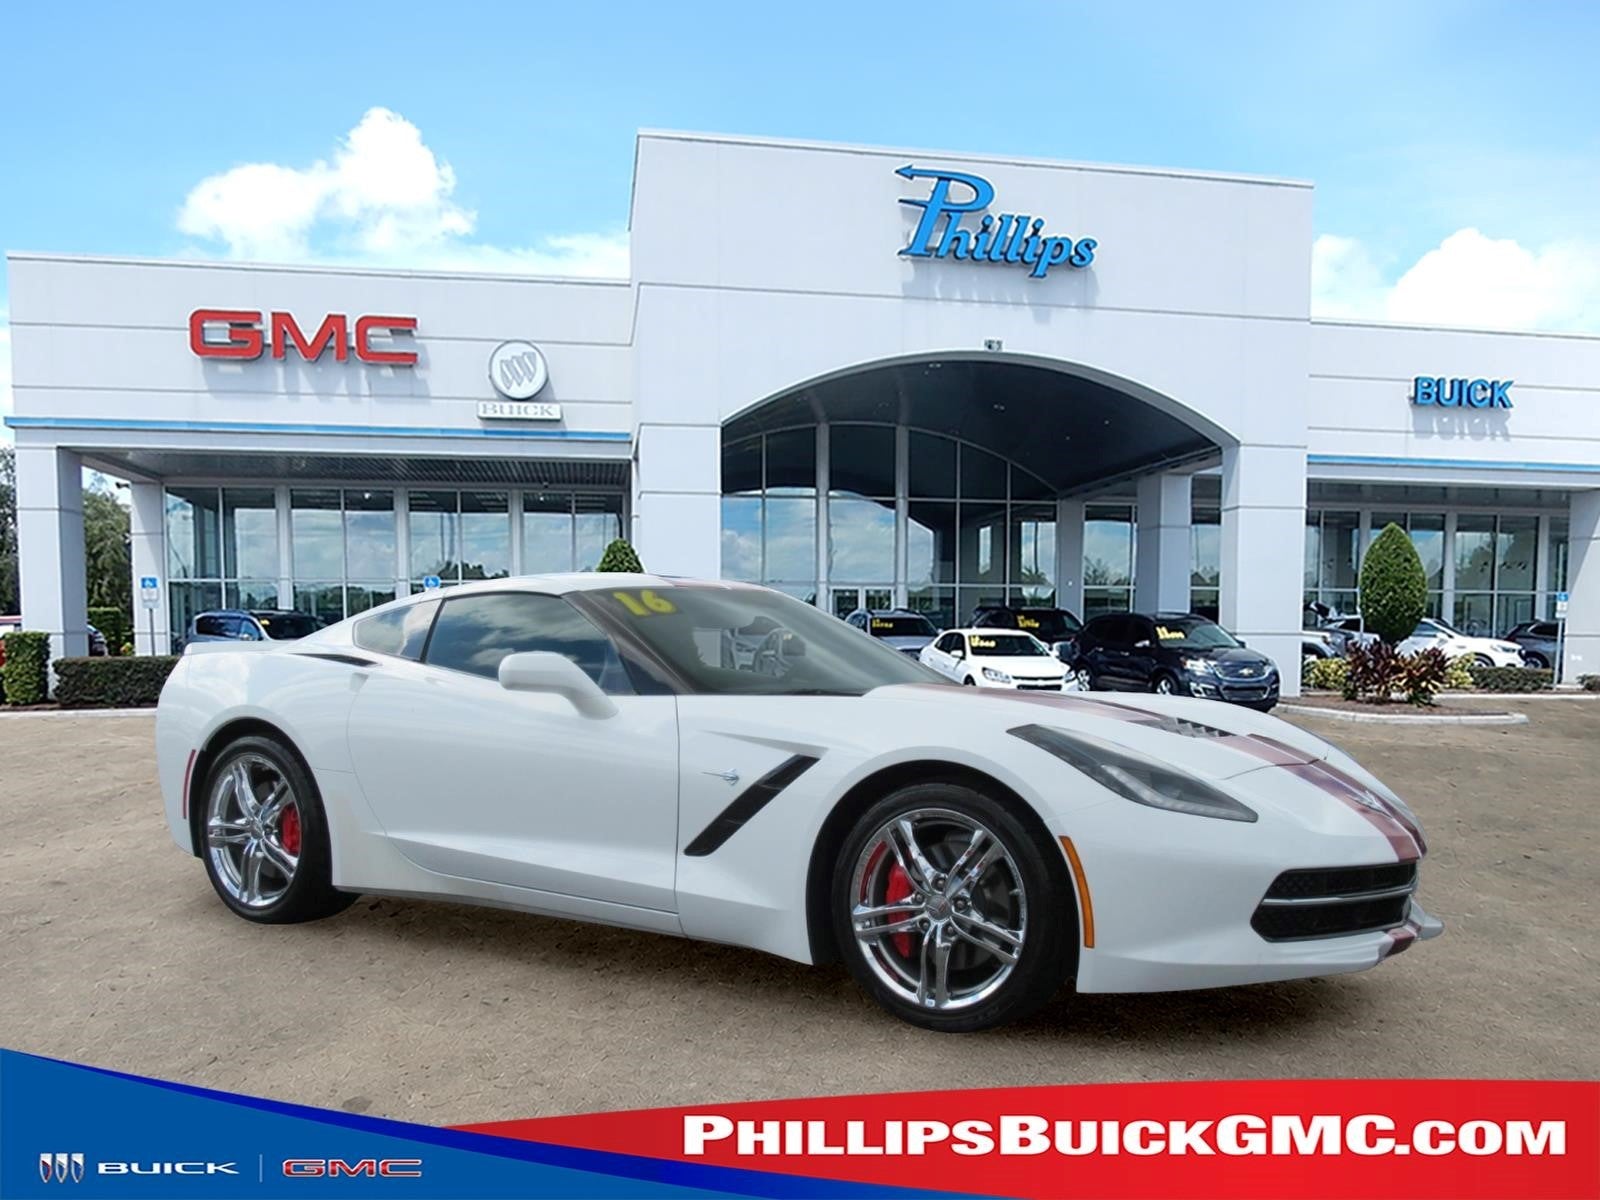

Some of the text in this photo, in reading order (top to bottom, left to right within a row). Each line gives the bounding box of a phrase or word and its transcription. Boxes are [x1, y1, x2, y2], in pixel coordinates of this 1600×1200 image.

[895, 165, 1098, 278] Phillips
[189, 308, 418, 364] GMC
[1413, 376, 1514, 408] BUICK
[482, 403, 554, 416] BUICK
[613, 589, 678, 616] 16
